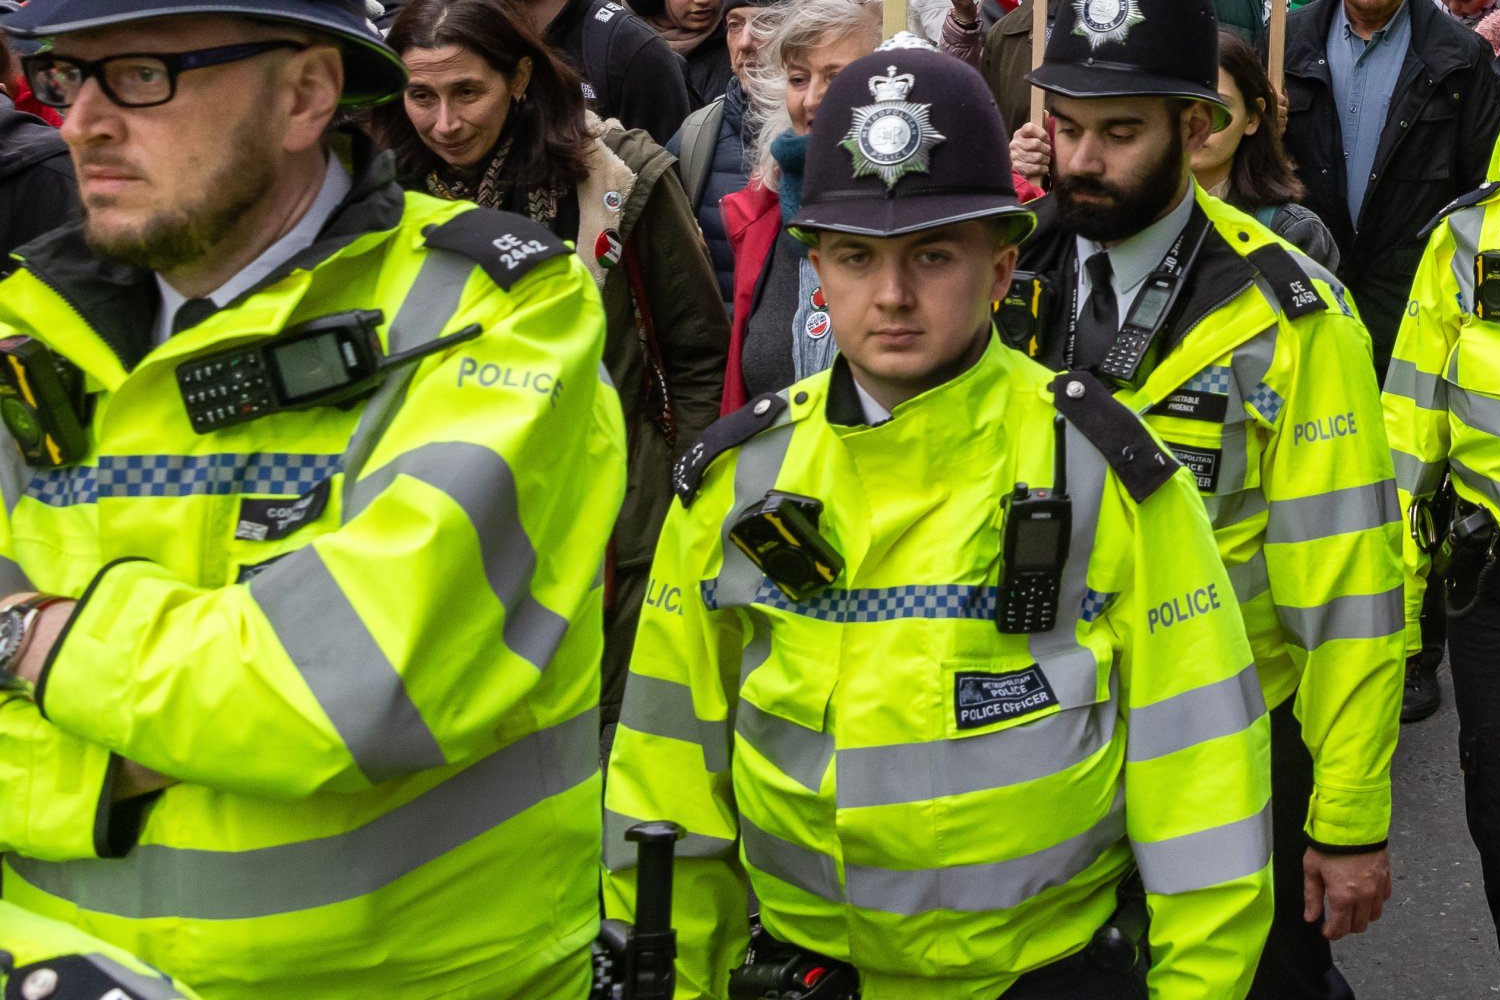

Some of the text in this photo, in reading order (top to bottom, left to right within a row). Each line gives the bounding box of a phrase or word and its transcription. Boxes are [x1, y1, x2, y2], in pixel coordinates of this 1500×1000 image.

[492, 233, 523, 251] CE
[500, 239, 550, 270] 2442
[1289, 280, 1306, 294] CE
[457, 356, 565, 410] POLICE
[1293, 411, 1358, 447] POLICE
[1147, 582, 1221, 635] POLICE
[960, 691, 1050, 722] POLICE OFFICER
[990, 684, 1028, 698] POLICE
